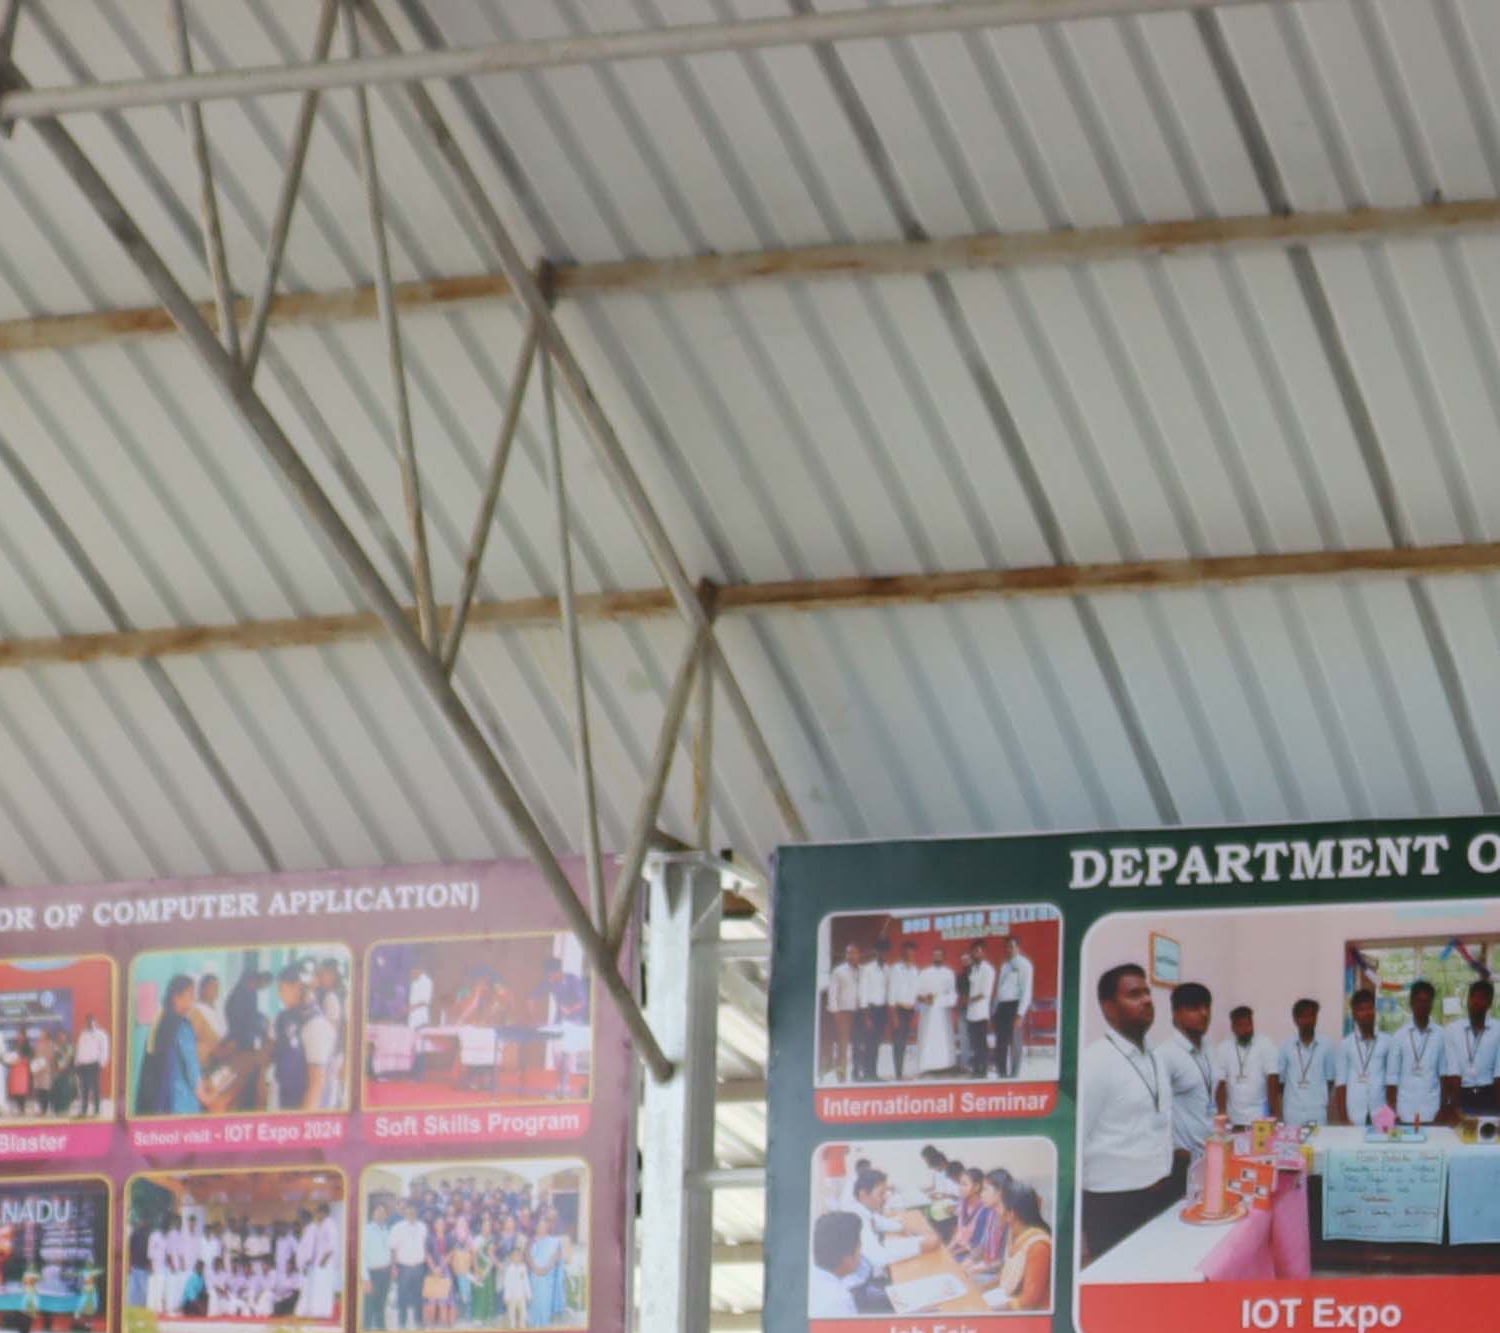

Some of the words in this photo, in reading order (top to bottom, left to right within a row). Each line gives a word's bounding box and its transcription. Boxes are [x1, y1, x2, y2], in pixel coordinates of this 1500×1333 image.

[1069, 834, 1450, 889] DEPARTMENT
[43, 905, 83, 930] OF
[93, 895, 259, 926] COMPUTER
[269, 881, 480, 916] APPLICATION)
[823, 1092, 954, 1117] International
[960, 1090, 1049, 1113] Seminar
[224, 1124, 253, 1143] IOT
[258, 1123, 298, 1144] Expo
[303, 1121, 341, 1140] 2024
[374, 1117, 418, 1137] Soft
[423, 1114, 481, 1137] Skills
[488, 1111, 579, 1137] Program
[1241, 1298, 1302, 1329] IOT
